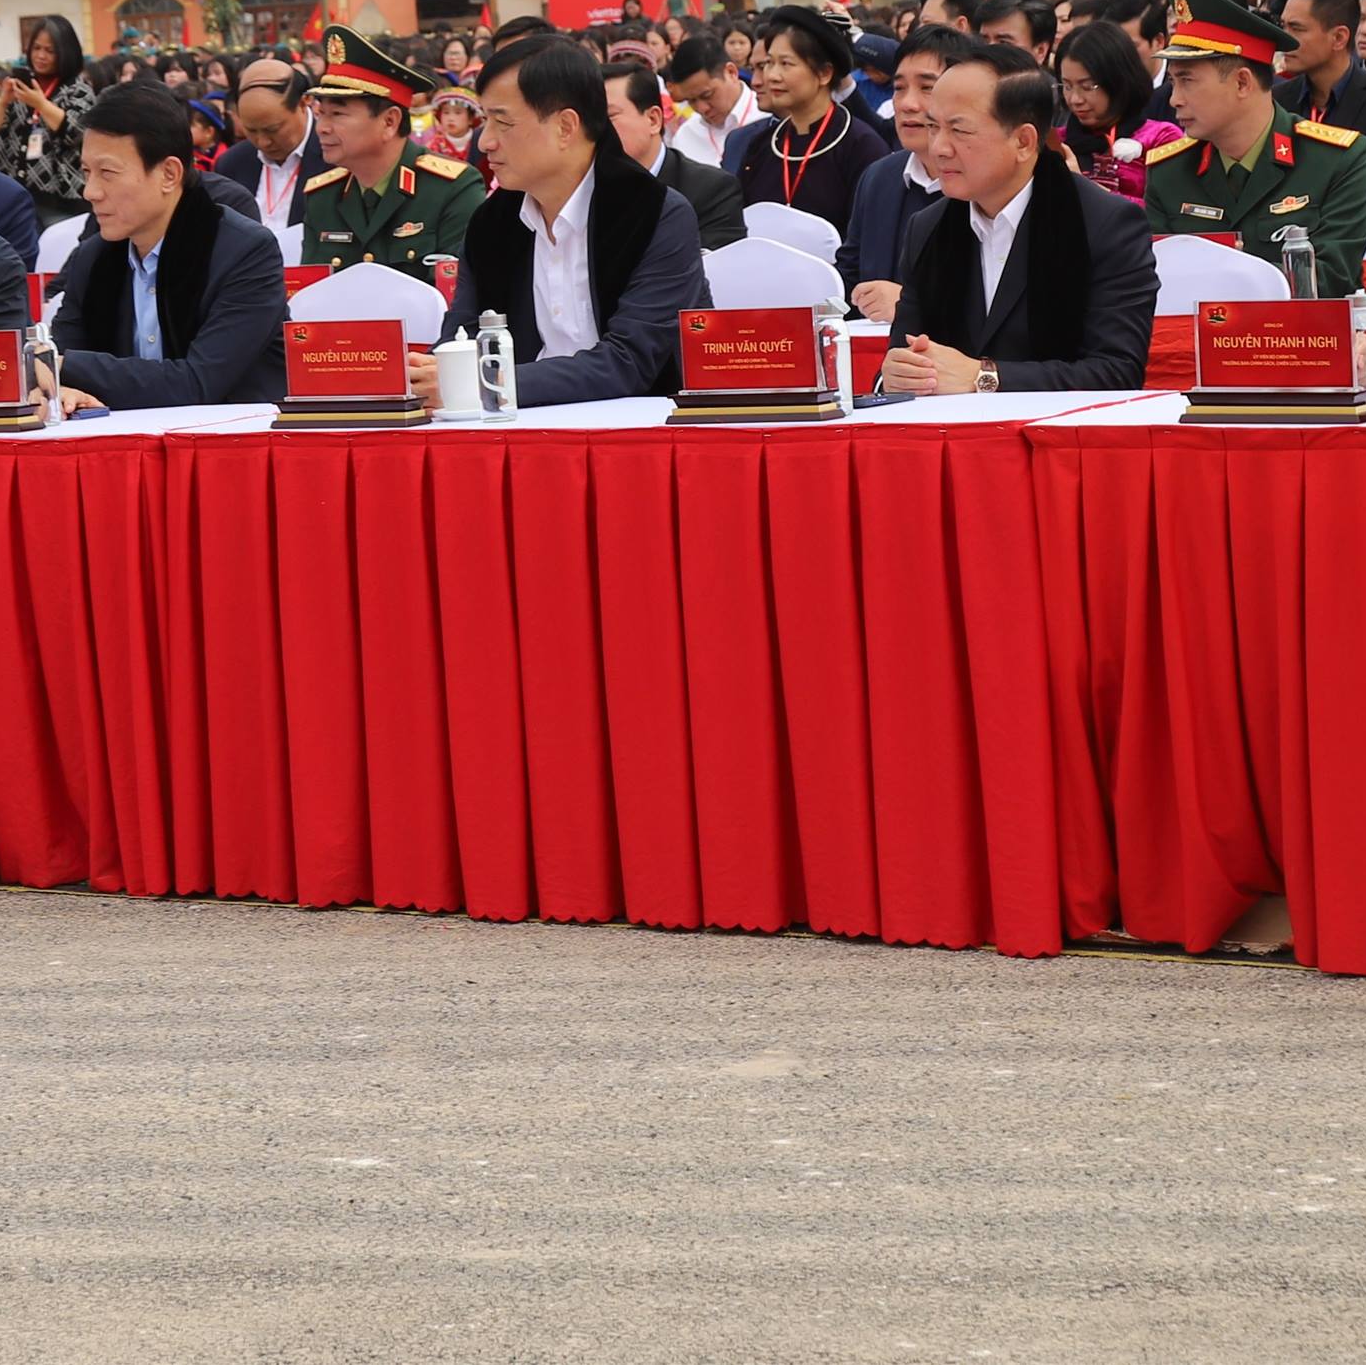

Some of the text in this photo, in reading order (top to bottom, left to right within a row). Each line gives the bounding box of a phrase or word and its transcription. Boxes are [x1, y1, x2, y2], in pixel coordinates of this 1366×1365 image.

[702, 337, 794, 356] TRỊNH VĂN QUYẾT
[1213, 332, 1338, 351] NGUYỄN THANH NGHỊ
[302, 348, 388, 364] NGUYỄN DUY NGỌC
